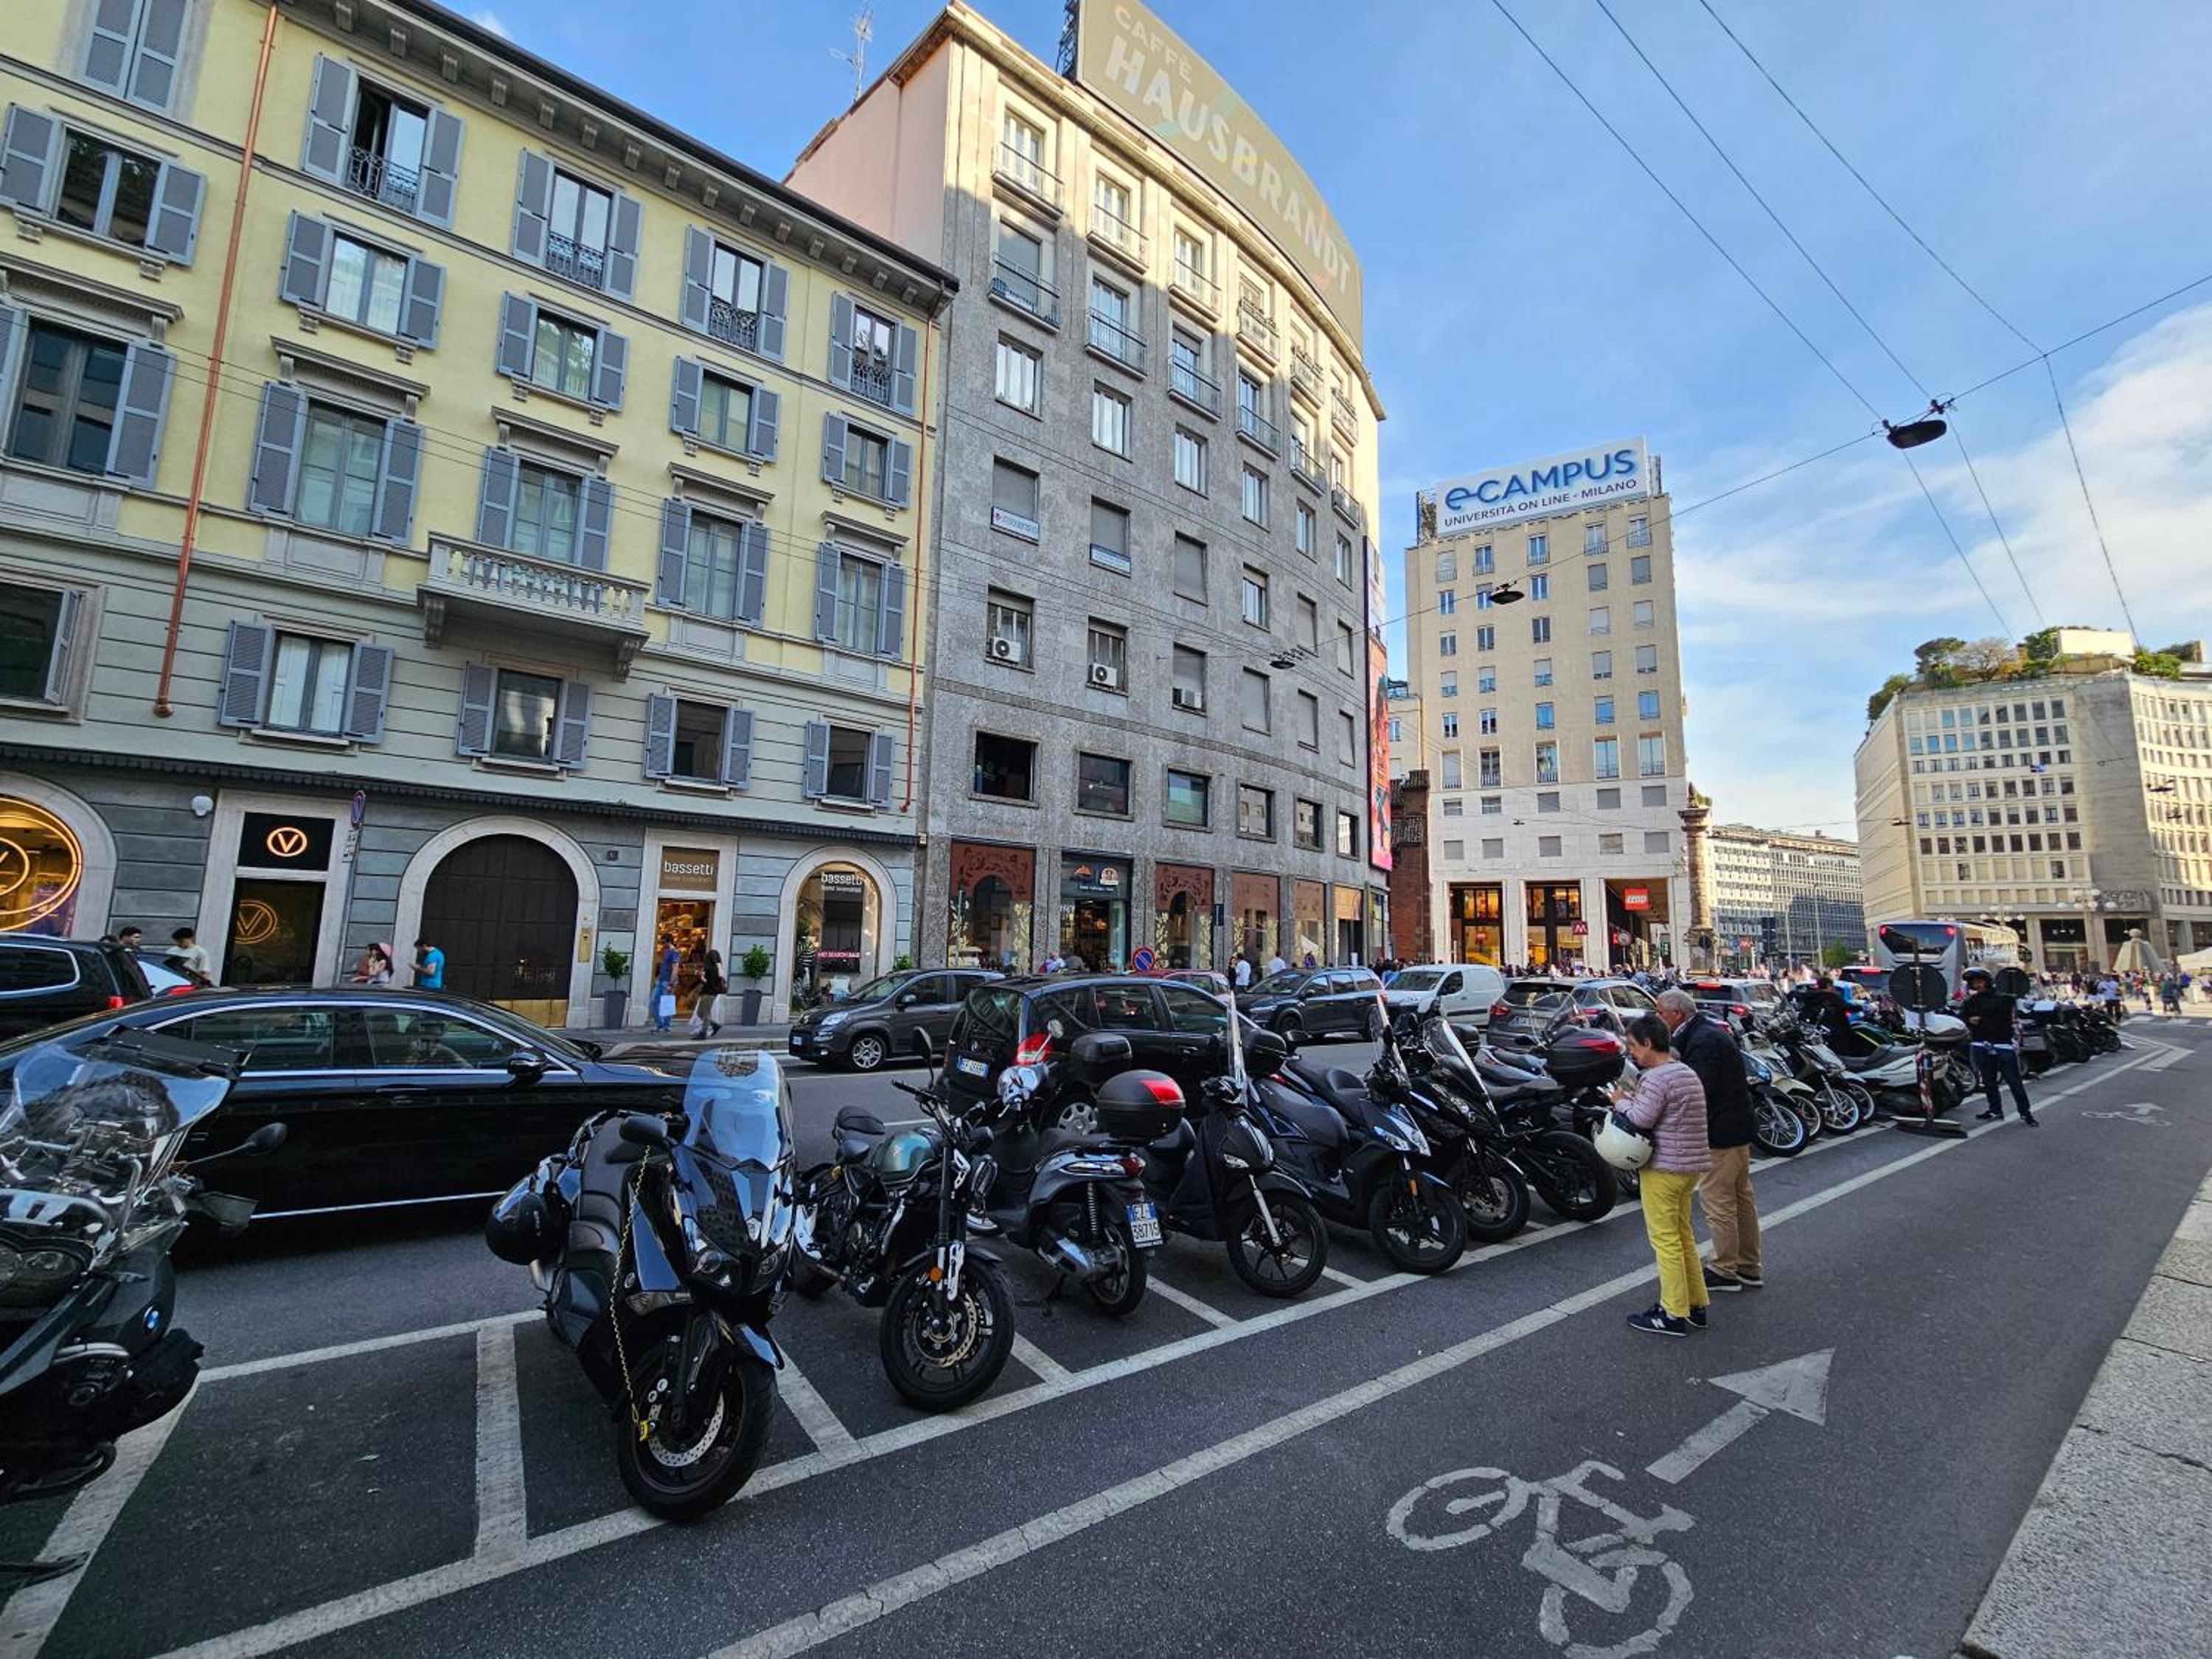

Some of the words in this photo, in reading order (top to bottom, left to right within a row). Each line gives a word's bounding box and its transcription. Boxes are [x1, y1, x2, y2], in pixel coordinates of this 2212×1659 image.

[1106, 35, 1350, 293] HAUSBRANDT
[1444, 505, 1515, 527] UNIVERSITÀ
[1519, 500, 1538, 511] ON
[1542, 494, 1569, 507] LINE
[1582, 479, 1637, 498] MILANO
[664, 860, 714, 875] bassetti
